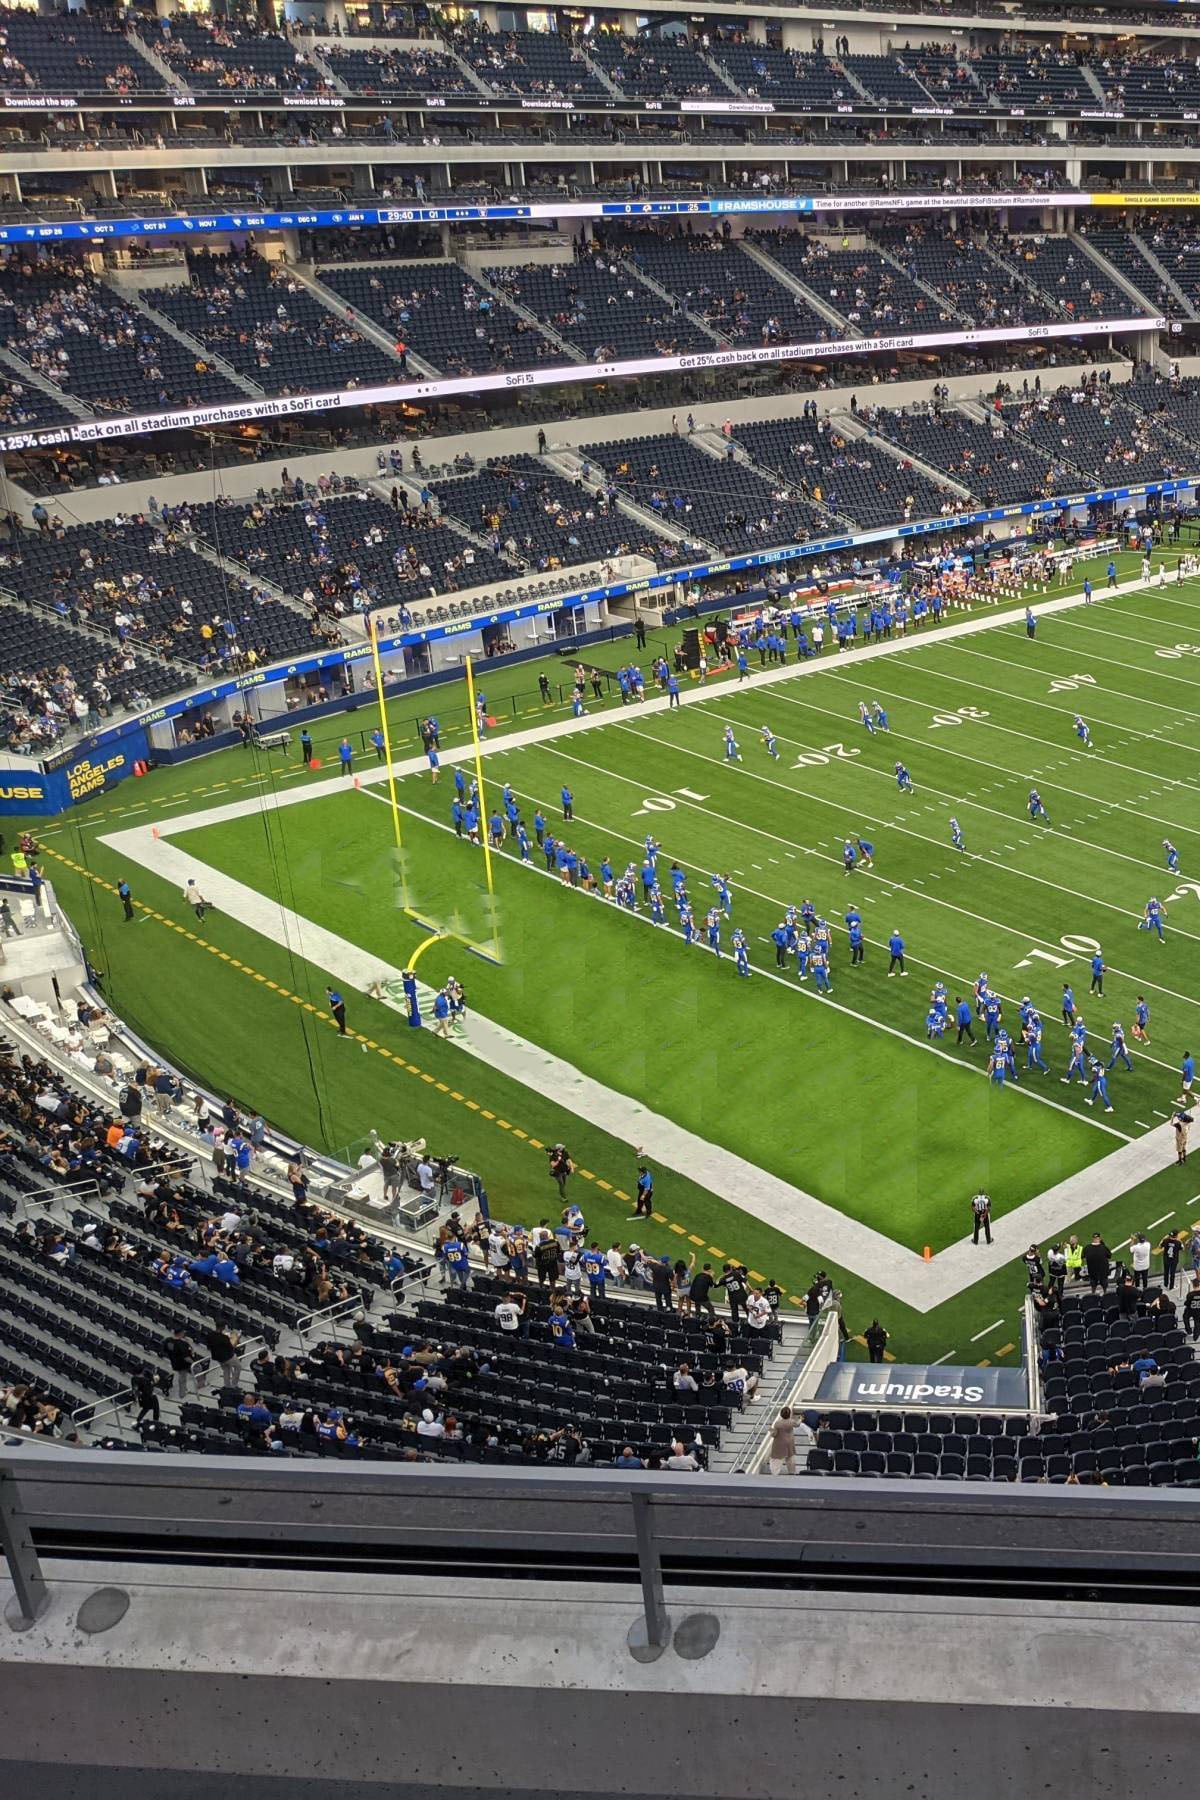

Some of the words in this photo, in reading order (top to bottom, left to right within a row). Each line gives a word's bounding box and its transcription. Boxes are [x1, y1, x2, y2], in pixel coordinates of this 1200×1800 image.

[5, 98, 45, 106] Download
[46, 98, 59, 106] the
[60, 100, 78, 108] app.
[174, 98, 188, 106] SoFi
[284, 97, 318, 106] Download
[318, 98, 330, 106] the
[522, 100, 550, 108] Download
[551, 100, 560, 108] the
[625, 205, 631, 213] 0
[717, 200, 797, 211] #RAMSHOUSE
[816, 200, 832, 208] Time
[833, 200, 842, 208] for
[843, 199, 868, 208] another
[869, 199, 905, 208] @RamsNFL
[906, 199, 923, 207] game
[387, 211, 414, 221] 29:40
[429, 211, 438, 219] Q1
[1028, 328, 1042, 337] SoFi
[680, 357, 696, 368] Get
[697, 355, 715, 366] 25%
[716, 354, 735, 364] cash
[737, 351, 757, 362] back
[759, 351, 769, 360] on
[771, 348, 780, 358] all
[782, 345, 814, 358] stadium
[815, 343, 854, 357] purchases
[856, 340, 871, 351] with
[879, 338, 895, 349] SoFi
[896, 338, 914, 348] card
[506, 375, 525, 386] SoFi
[9, 435, 37, 450] 25%
[39, 429, 70, 445] cash
[71, 425, 103, 441] back
[106, 425, 122, 435] on
[125, 420, 139, 433] all
[142, 414, 190, 431] stadium
[193, 407, 252, 426] purchases
[255, 402, 280, 416] with
[282, 403, 288, 412] a
[290, 398, 314, 411] SoFi
[316, 395, 341, 408] card
[707, 563, 731, 574] RAMS
[625, 580, 650, 593] RAMS
[537, 600, 564, 612] RAMS
[444, 622, 472, 636] RAMS
[343, 645, 372, 660] RAMS
[236, 672, 266, 690] RAMS
[1054, 672, 1098, 692] 40
[139, 708, 166, 726] RAMS
[932, 706, 990, 728] 30
[797, 742, 861, 767] 20
[67, 760, 91, 779] LOS
[69, 754, 125, 790] ANGELES
[71, 774, 105, 799] RAMS
[0, 787, 44, 800] USE
[641, 786, 711, 812] 10
[1026, 934, 1101, 969] 10
[447, 1251, 462, 1262] 99
[586, 1264, 600, 1275] 99
[500, 1313, 513, 1323] 98
[551, 1324, 563, 1337] 10
[857, 1382, 985, 1402] Stadium
